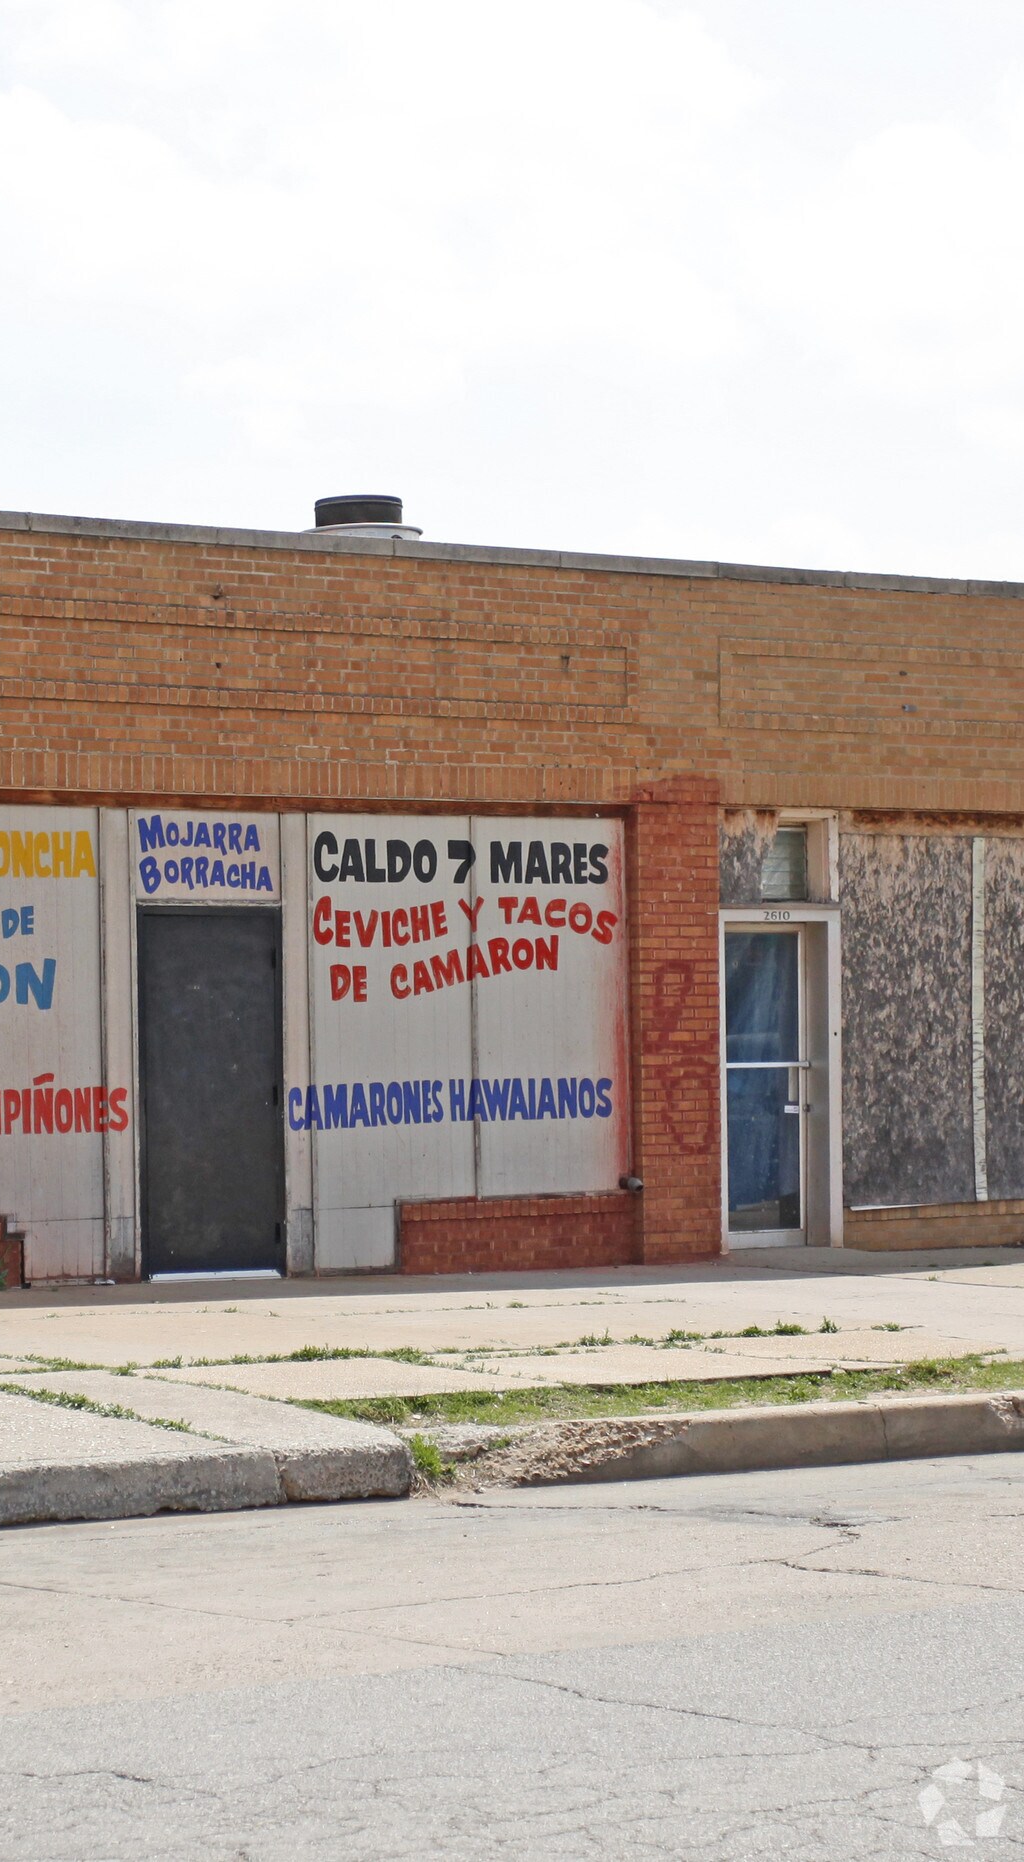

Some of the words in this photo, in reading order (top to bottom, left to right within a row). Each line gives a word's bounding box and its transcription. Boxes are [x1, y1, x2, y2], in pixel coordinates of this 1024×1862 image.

[137, 814, 261, 857] MOJARRA
[313, 830, 438, 884] CALDO
[447, 839, 476, 884] 7
[490, 840, 610, 885] MARES
[138, 855, 274, 895] BORRACHA
[1, 905, 35, 939] DE
[313, 895, 449, 948] CEVICHE
[458, 896, 485, 933] Y
[498, 896, 619, 945] TACOS
[762, 910, 791, 921] 2610
[329, 964, 368, 1003] DE
[390, 935, 560, 1000] CAMARON
[288, 1079, 445, 1131] CAMARONES
[448, 1077, 614, 1123] HAWAIANOS
